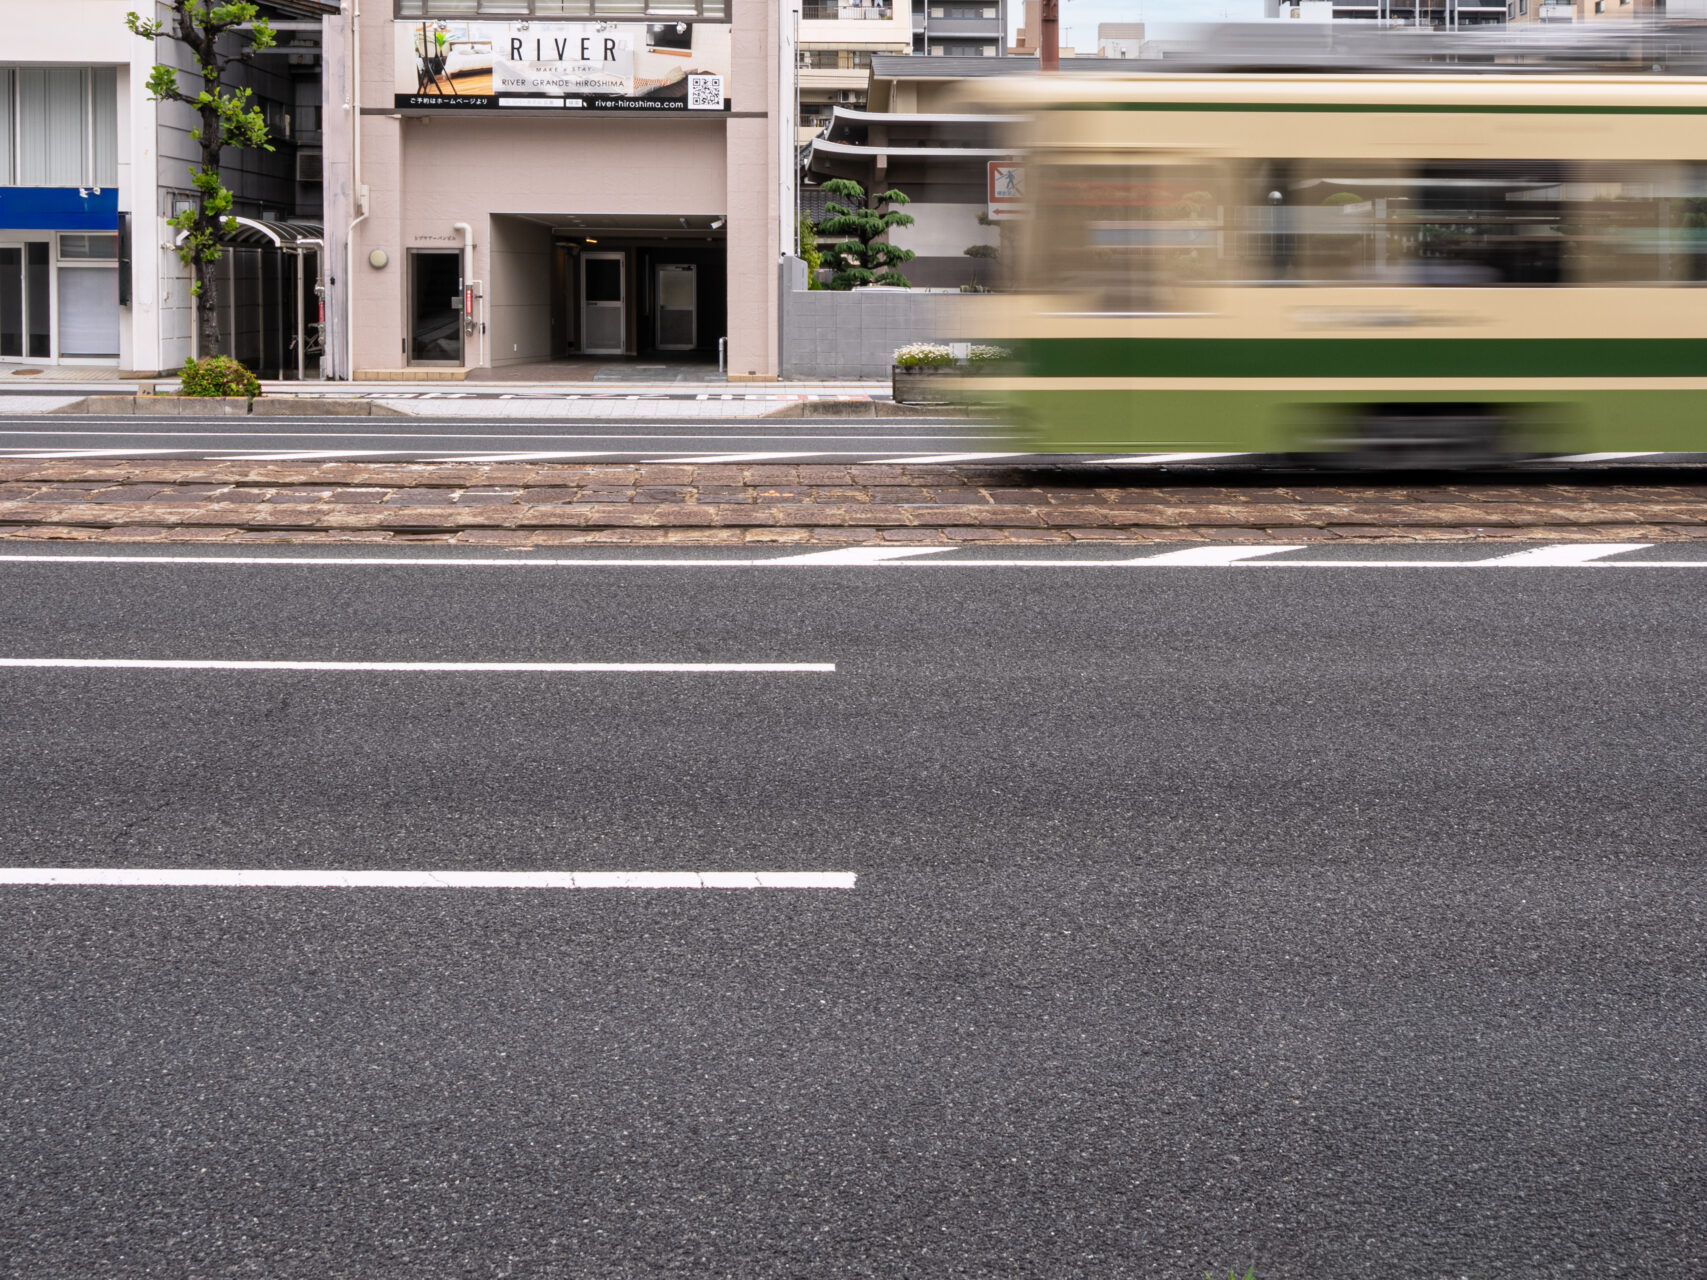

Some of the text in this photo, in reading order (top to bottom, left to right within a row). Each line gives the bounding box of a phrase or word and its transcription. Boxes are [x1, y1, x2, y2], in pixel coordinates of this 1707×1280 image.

[510, 37, 617, 61] RIVER
[532, 79, 569, 87] GRANDE
[595, 100, 684, 108] river-hiroshima.com
